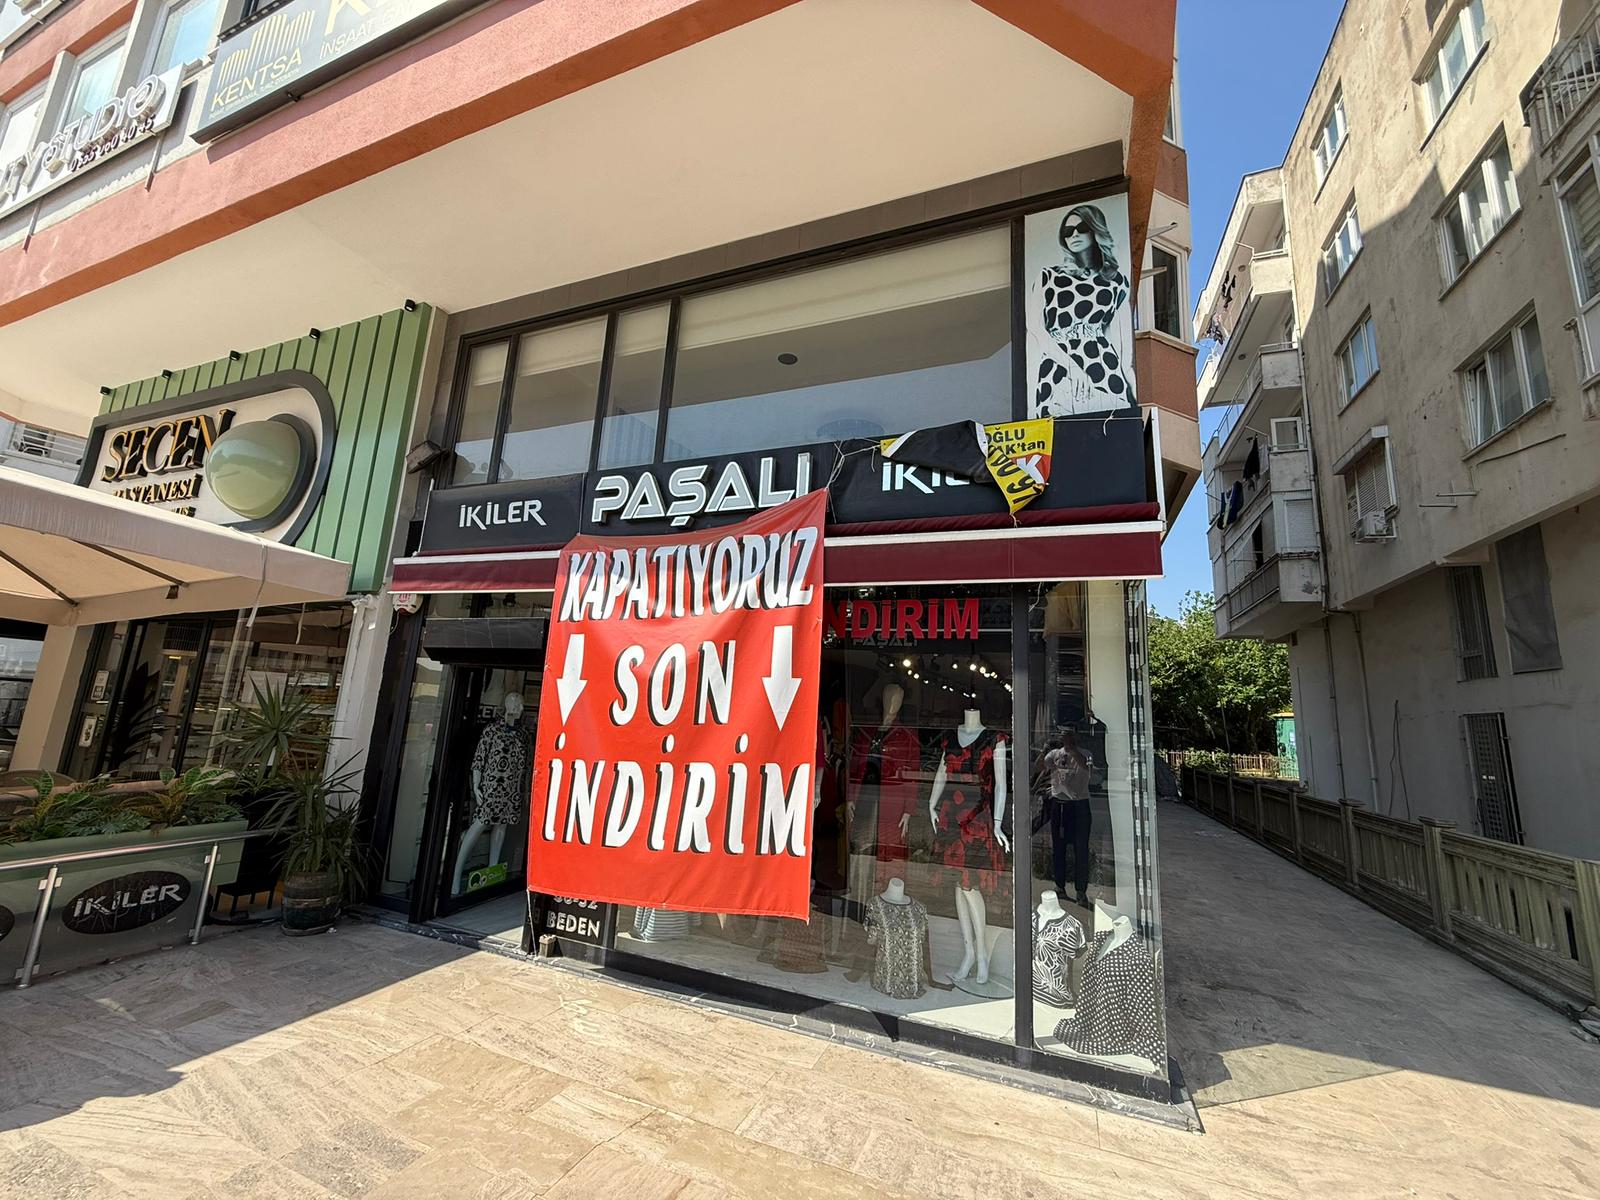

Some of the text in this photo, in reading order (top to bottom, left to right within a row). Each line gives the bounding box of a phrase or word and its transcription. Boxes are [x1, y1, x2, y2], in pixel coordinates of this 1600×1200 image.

[210, 47, 302, 112] KENTSA
[459, 499, 547, 530] İKİLER
[591, 452, 812, 527] PAŞALI
[558, 527, 819, 622] KAPATIYORUZ
[823, 598, 979, 639] NDİRİM
[609, 640, 736, 726] SON
[542, 732, 810, 857] İNDİRİM
[546, 910, 600, 938] BEDEN
